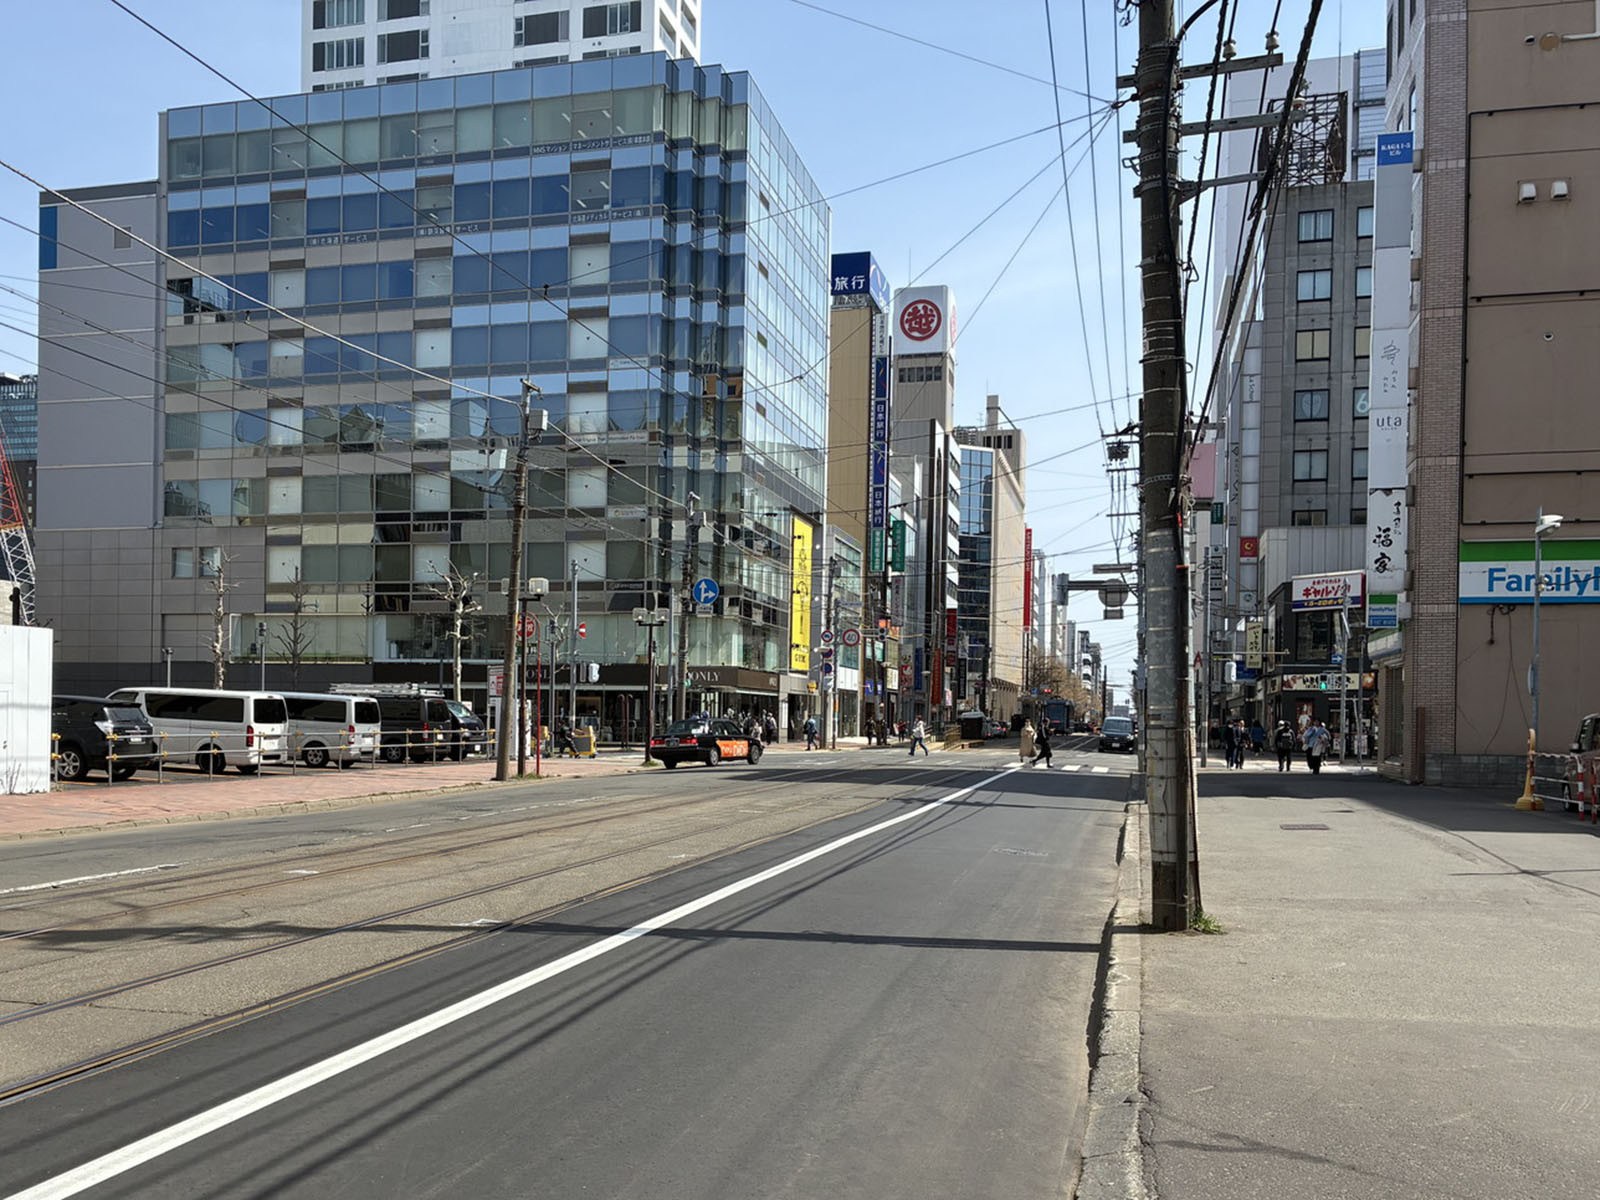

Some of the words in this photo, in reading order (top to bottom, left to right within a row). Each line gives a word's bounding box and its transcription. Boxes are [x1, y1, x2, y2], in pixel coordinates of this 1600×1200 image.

[828, 275, 865, 291] 旅行
[1376, 416, 1402, 427] uta
[1488, 566, 1600, 596] Family
[692, 671, 719, 682] ONLY
